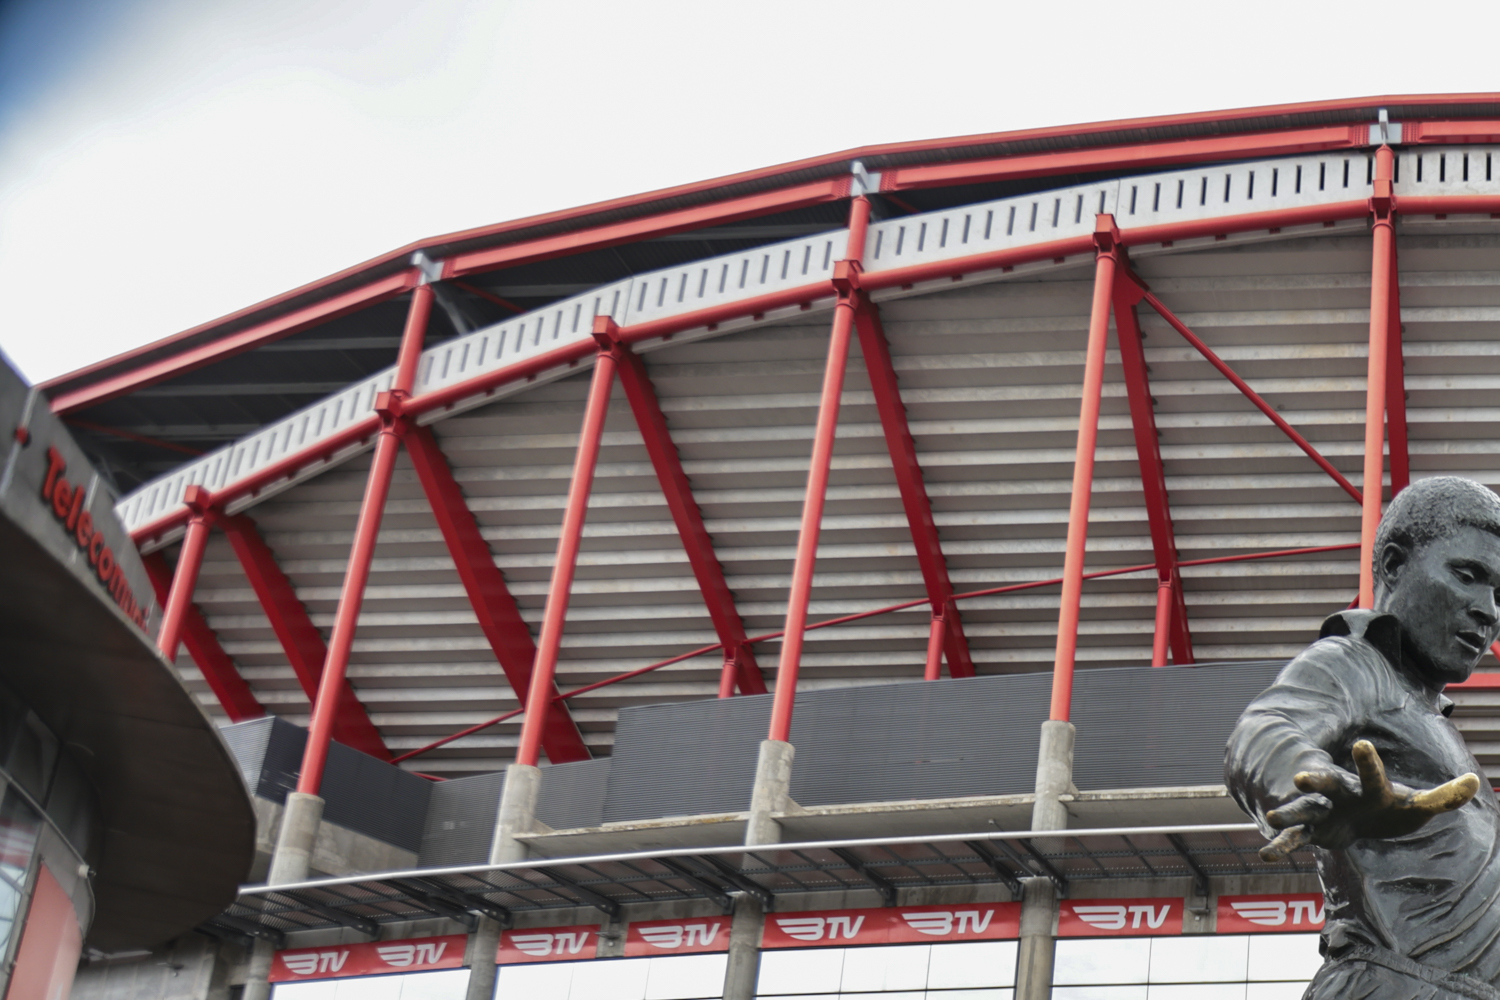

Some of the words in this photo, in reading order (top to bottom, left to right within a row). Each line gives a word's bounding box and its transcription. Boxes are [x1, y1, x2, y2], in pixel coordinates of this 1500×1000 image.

[776, 915, 865, 941] BTV
[901, 909, 994, 936] BTV
[1073, 904, 1171, 930] BTV
[511, 931, 588, 957] BTV
[637, 922, 721, 949] BTV
[282, 950, 350, 975] BTV
[376, 941, 447, 968] BTV
